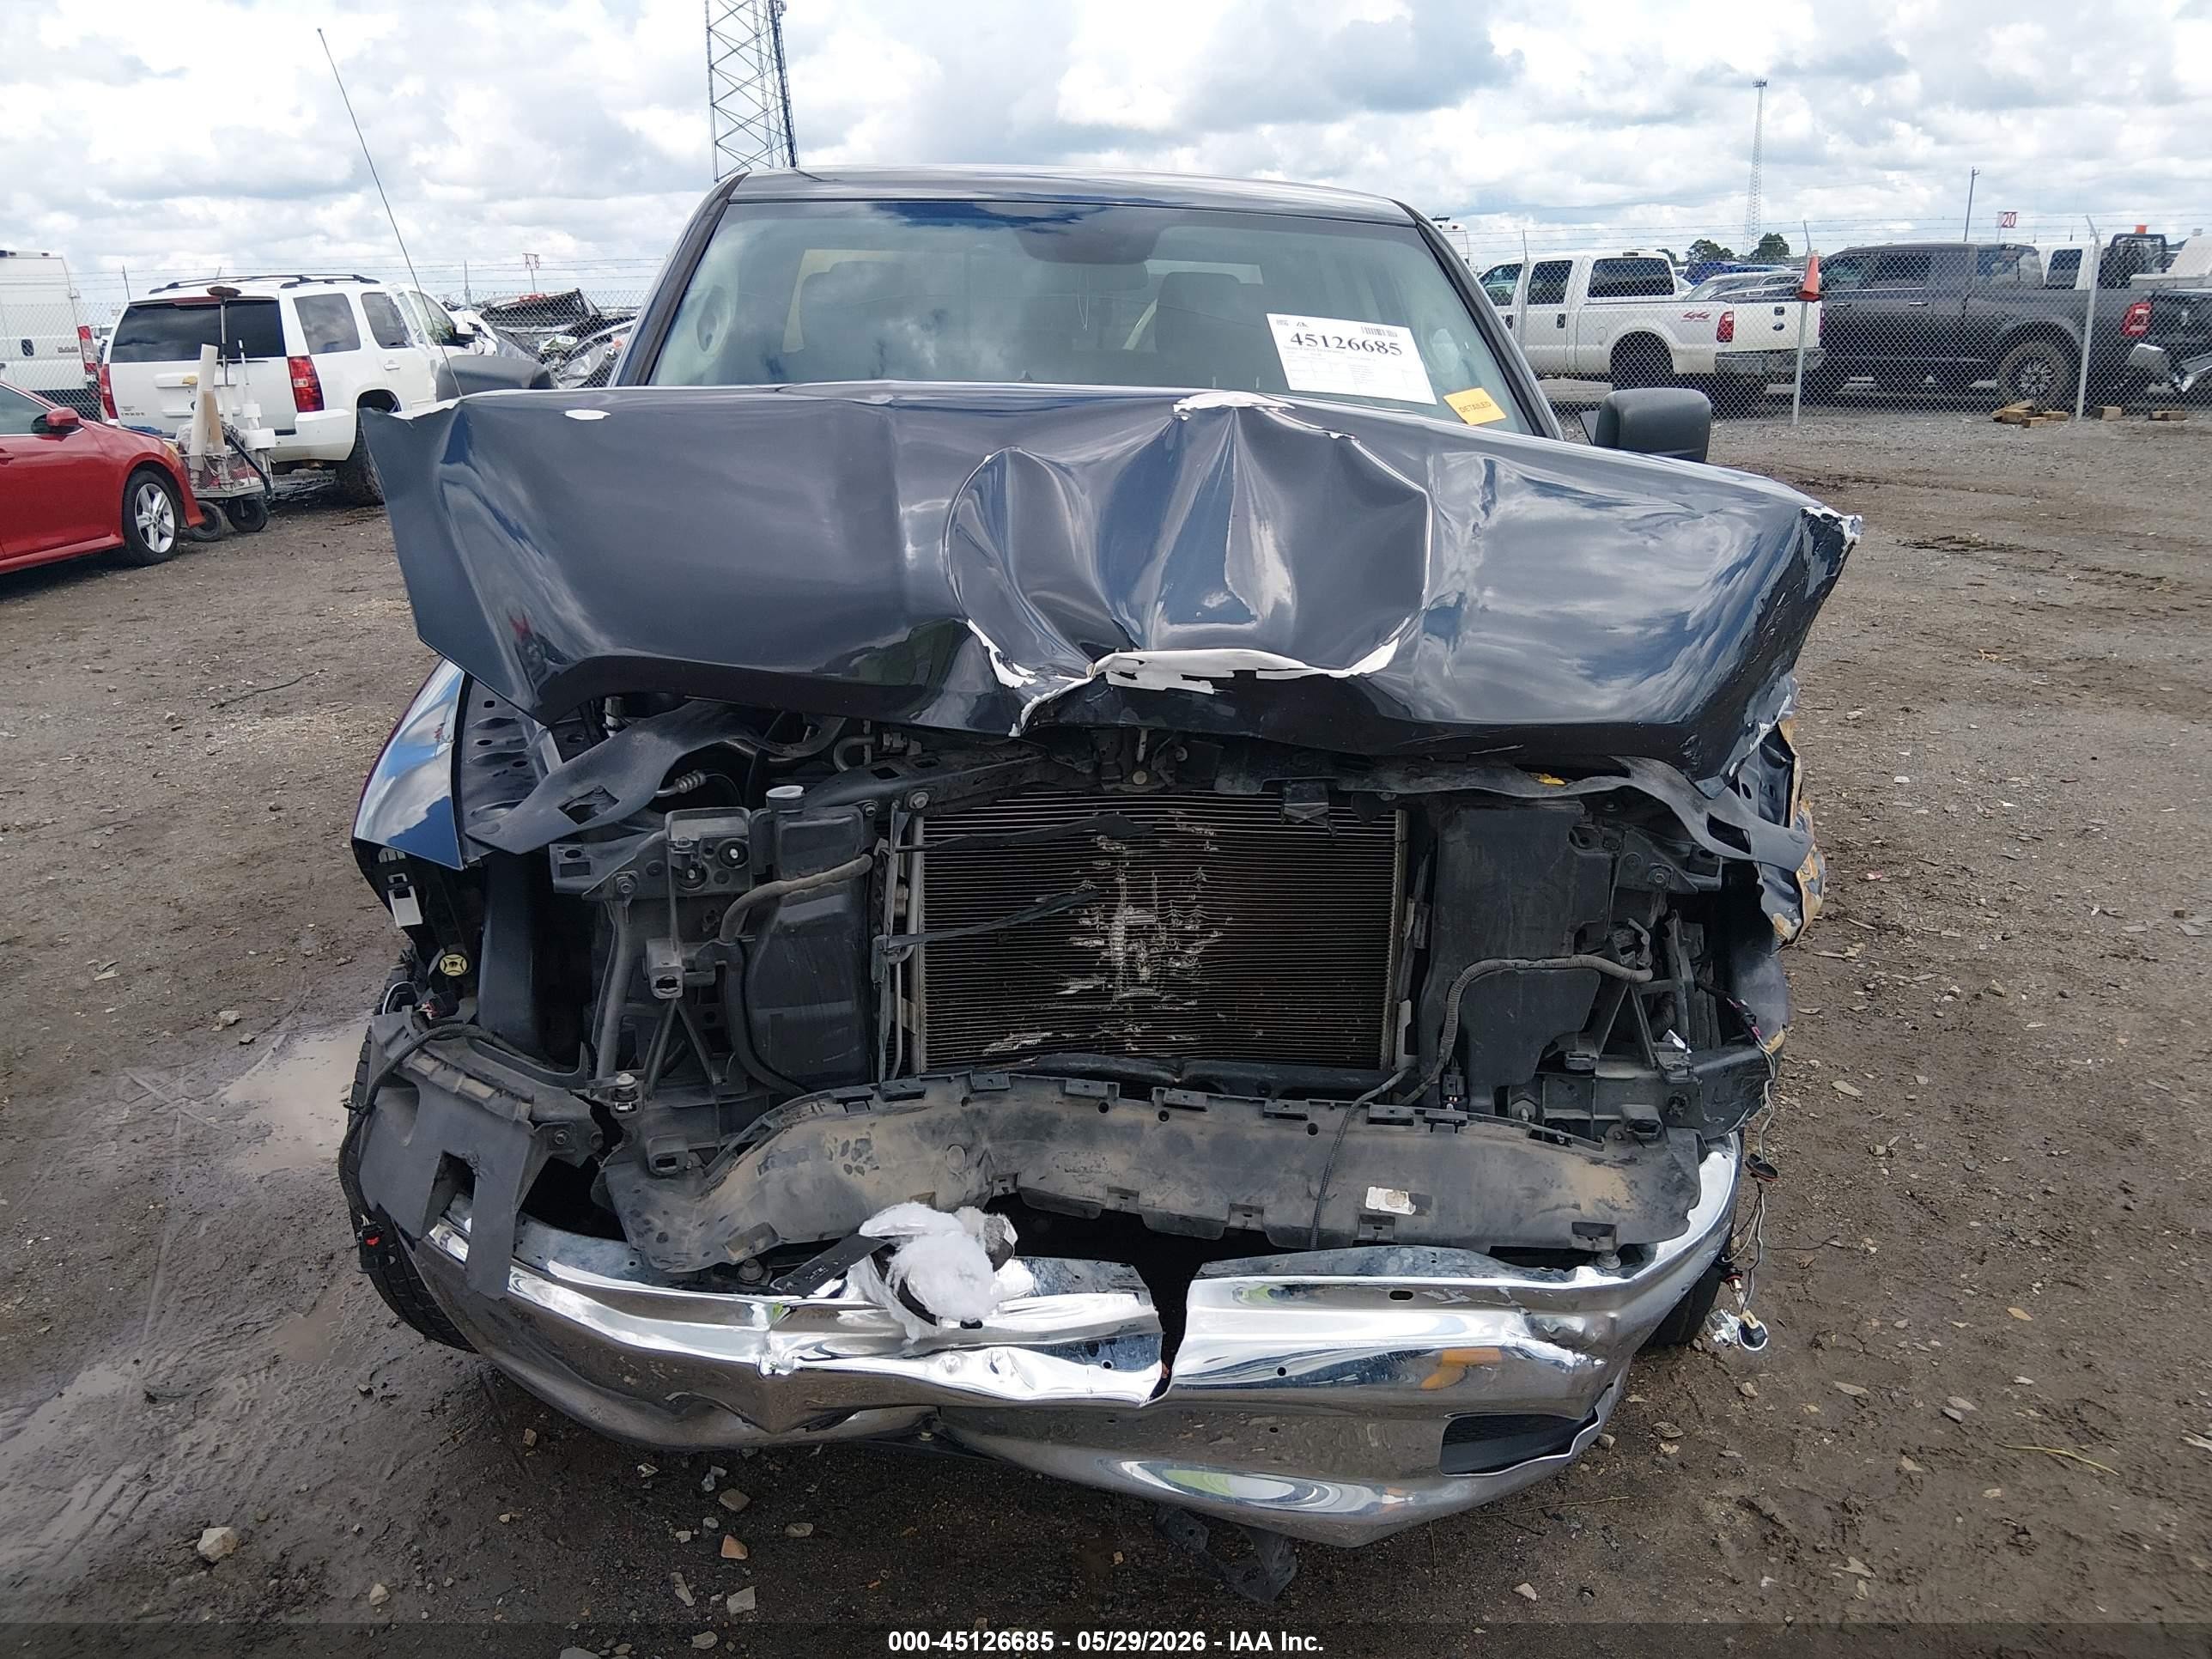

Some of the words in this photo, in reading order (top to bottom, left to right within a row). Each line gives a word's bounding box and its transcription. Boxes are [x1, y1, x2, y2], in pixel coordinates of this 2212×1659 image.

[2001, 211, 2017, 228] 20
[1290, 332, 1402, 356] 45126685
[1458, 401, 1492, 413] DETAILED
